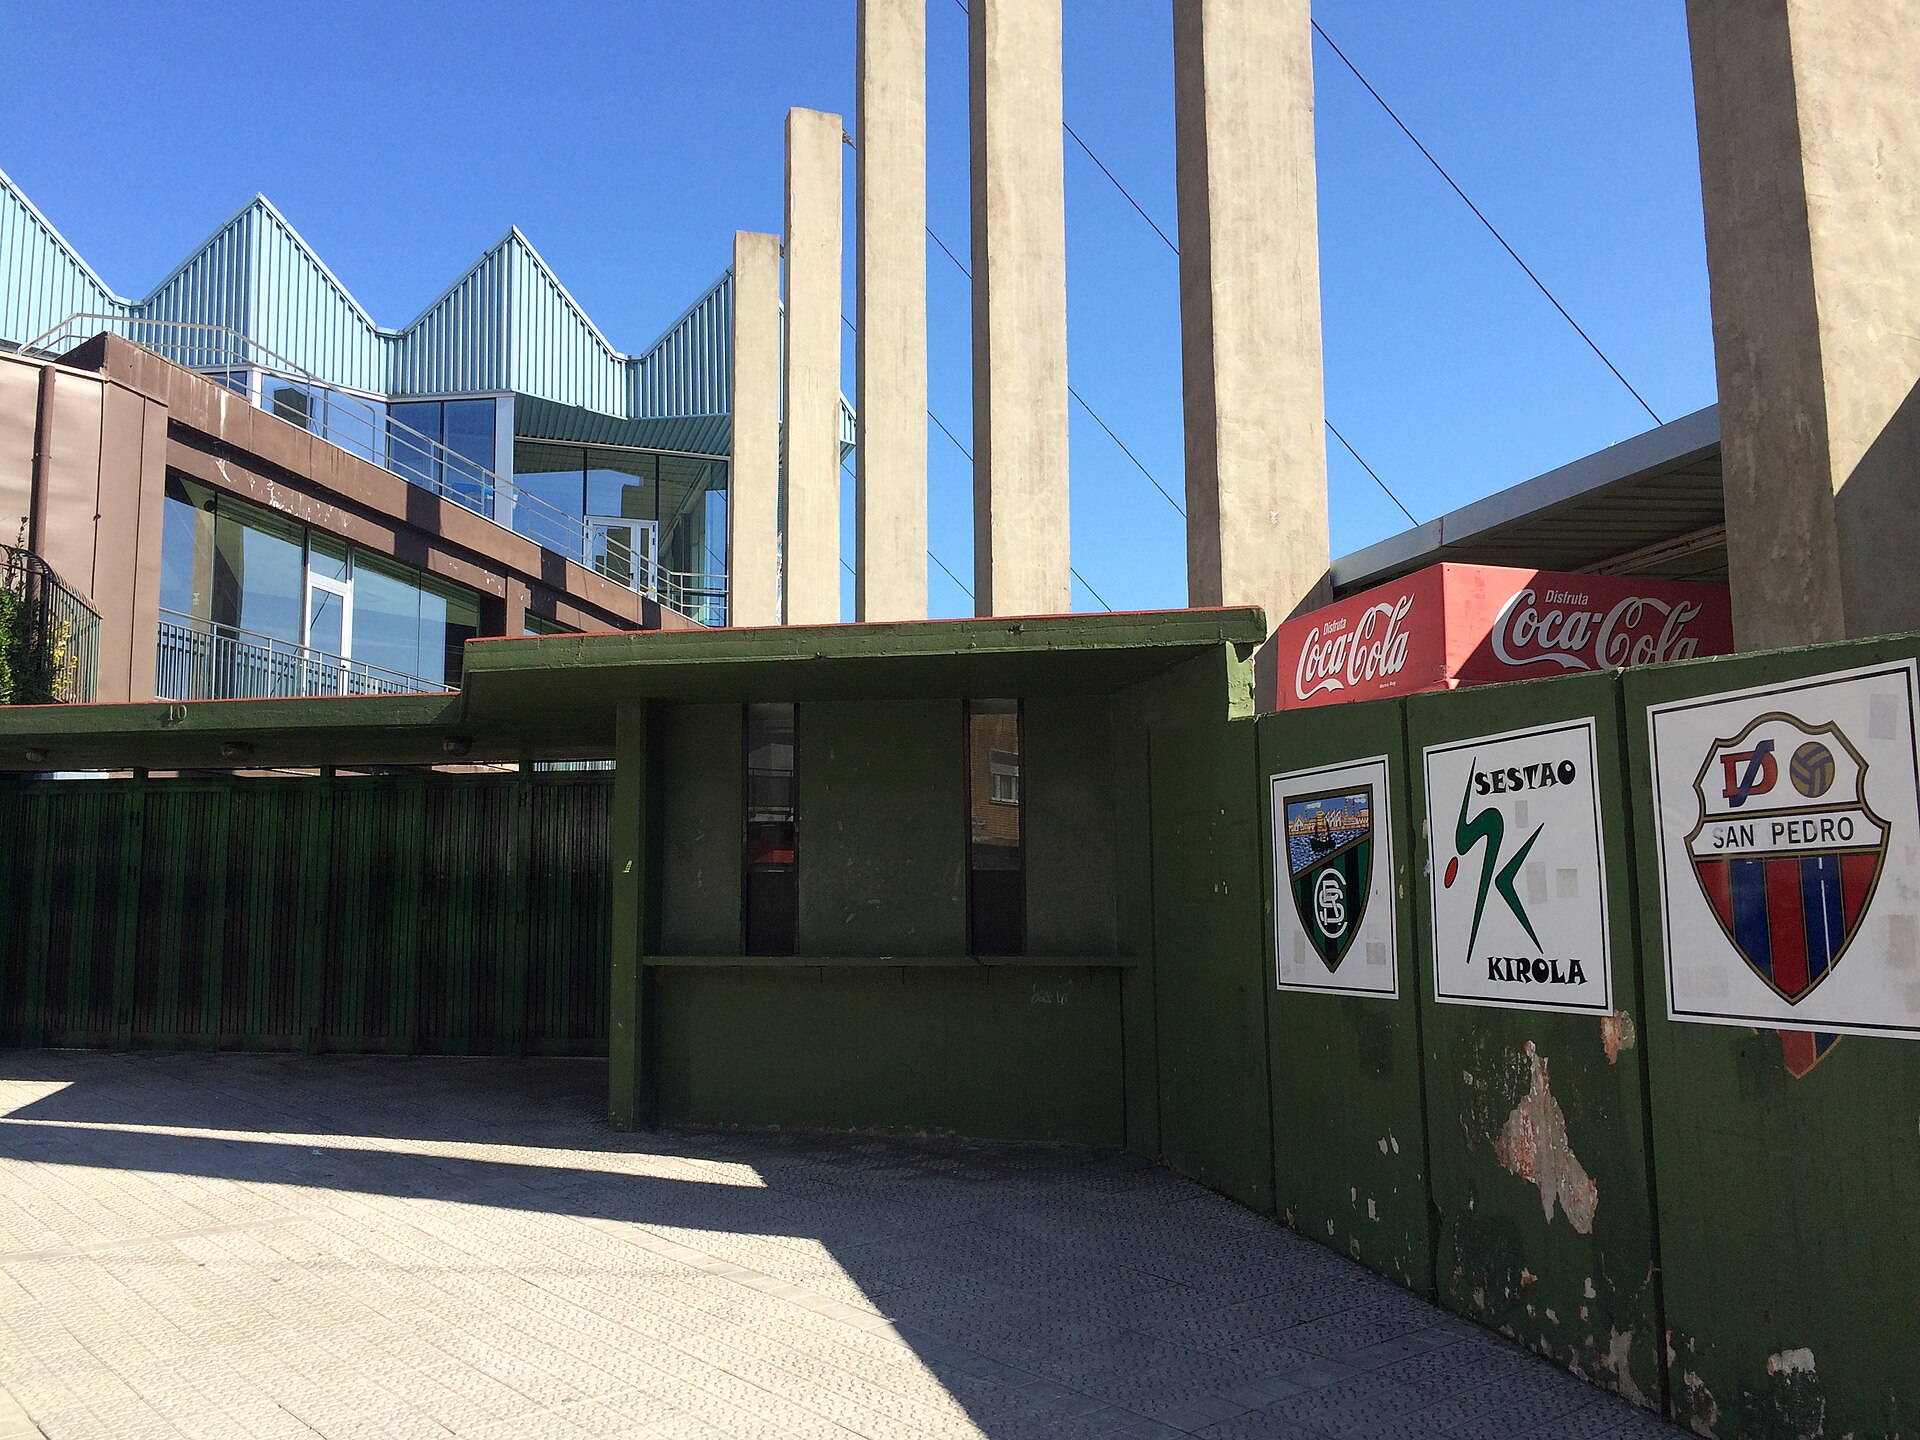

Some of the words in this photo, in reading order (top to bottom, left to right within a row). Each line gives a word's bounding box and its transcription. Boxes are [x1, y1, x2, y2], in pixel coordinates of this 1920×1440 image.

[1545, 589, 1589, 606] Disfruta
[1323, 617, 1347, 636] Disfruta
[1295, 593, 1415, 700] Coca-Cola
[1474, 759, 1577, 796] SESTAO
[1712, 824, 1755, 849] SAN
[1771, 817, 1855, 846] PEDRO
[1487, 957, 1588, 986] KIROLA
